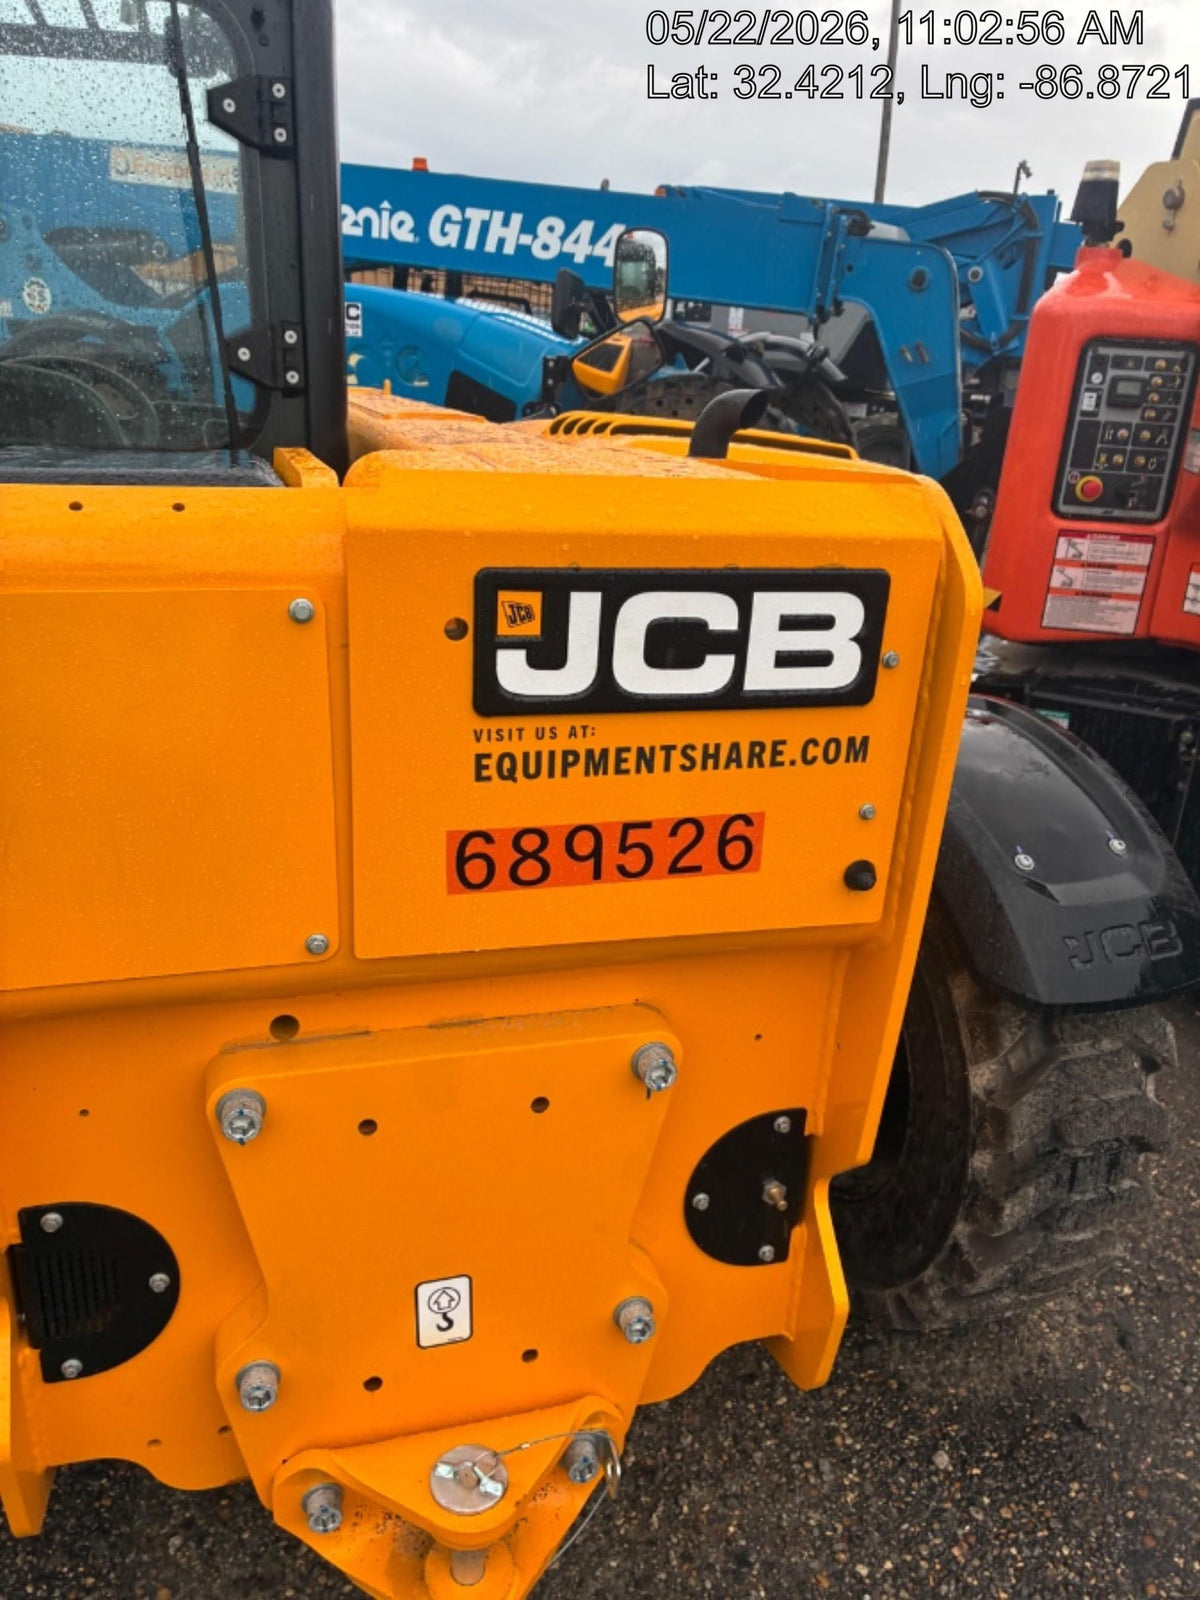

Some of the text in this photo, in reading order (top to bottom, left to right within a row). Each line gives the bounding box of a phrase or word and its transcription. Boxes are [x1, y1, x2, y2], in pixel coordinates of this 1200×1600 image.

[341, 200, 626, 267] enie GTH-844
[506, 603, 533, 625] JCB
[495, 591, 865, 697] JCB
[473, 725, 596, 743] VISIT US AT:
[473, 735, 870, 783] EQUIPMENTSHARE.COM
[455, 813, 755, 890] 689526
[1062, 920, 1183, 971] JCB
